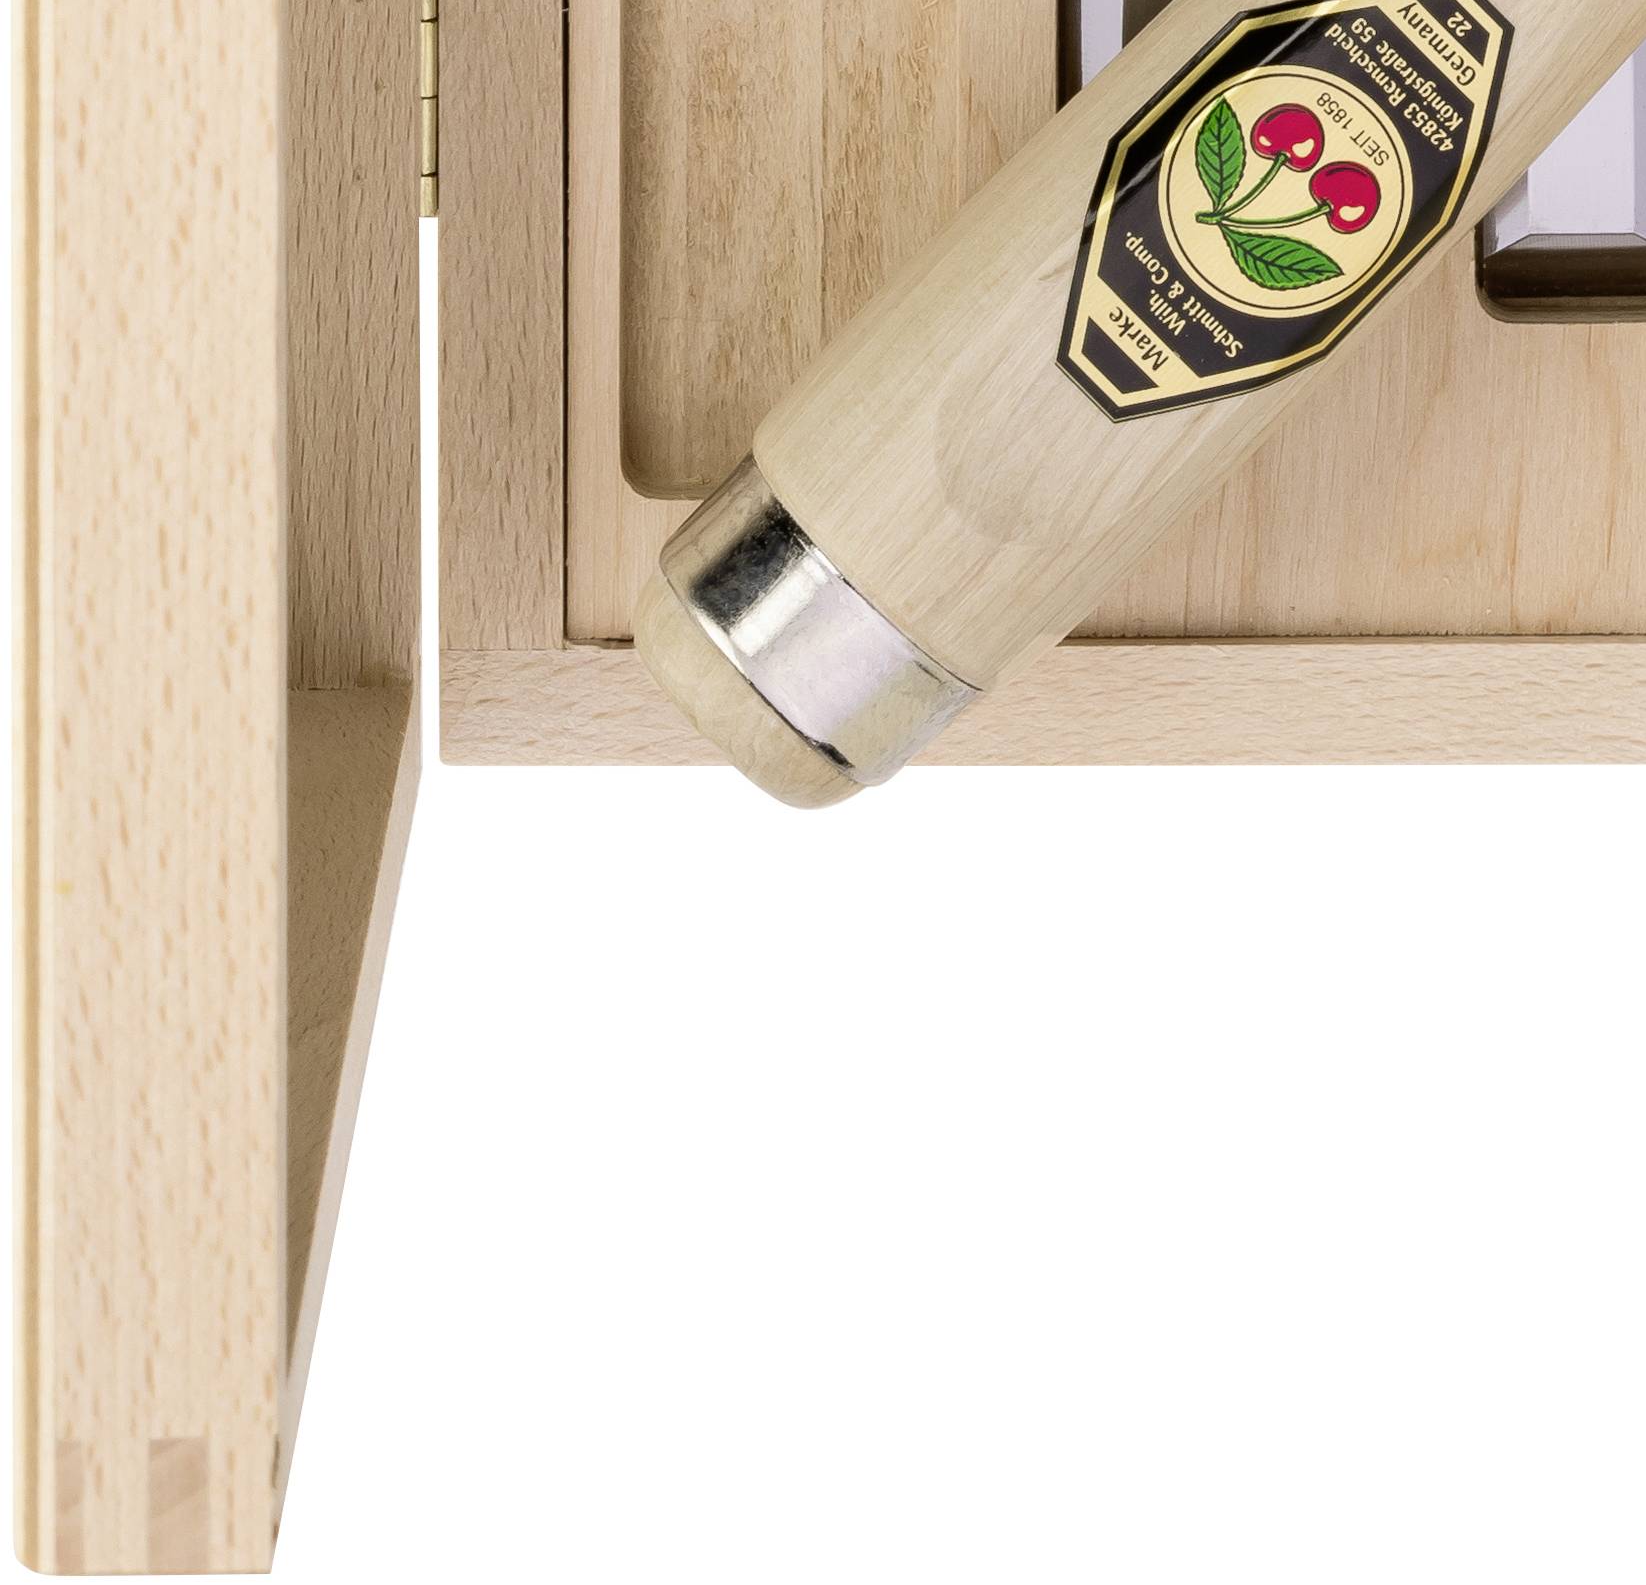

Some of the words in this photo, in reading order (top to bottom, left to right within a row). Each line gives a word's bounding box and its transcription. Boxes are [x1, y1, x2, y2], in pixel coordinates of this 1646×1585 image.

[1351, 17, 1377, 43] 59
[1397, 2, 1476, 87] Germany
[1447, 11, 1473, 37] 22
[1324, 23, 1406, 107] Remscheid
[1375, 40, 1464, 131] Königstraße
[1316, 92, 1354, 130] 1858
[1403, 102, 1454, 152] 42853
[1349, 129, 1390, 167] SEIT
[1125, 231, 1169, 285] Comp.
[1150, 289, 1186, 336] Wilh.
[1168, 280, 1184, 299] &
[1109, 306, 1169, 371] Marke
[1182, 296, 1243, 358] Schmitt
